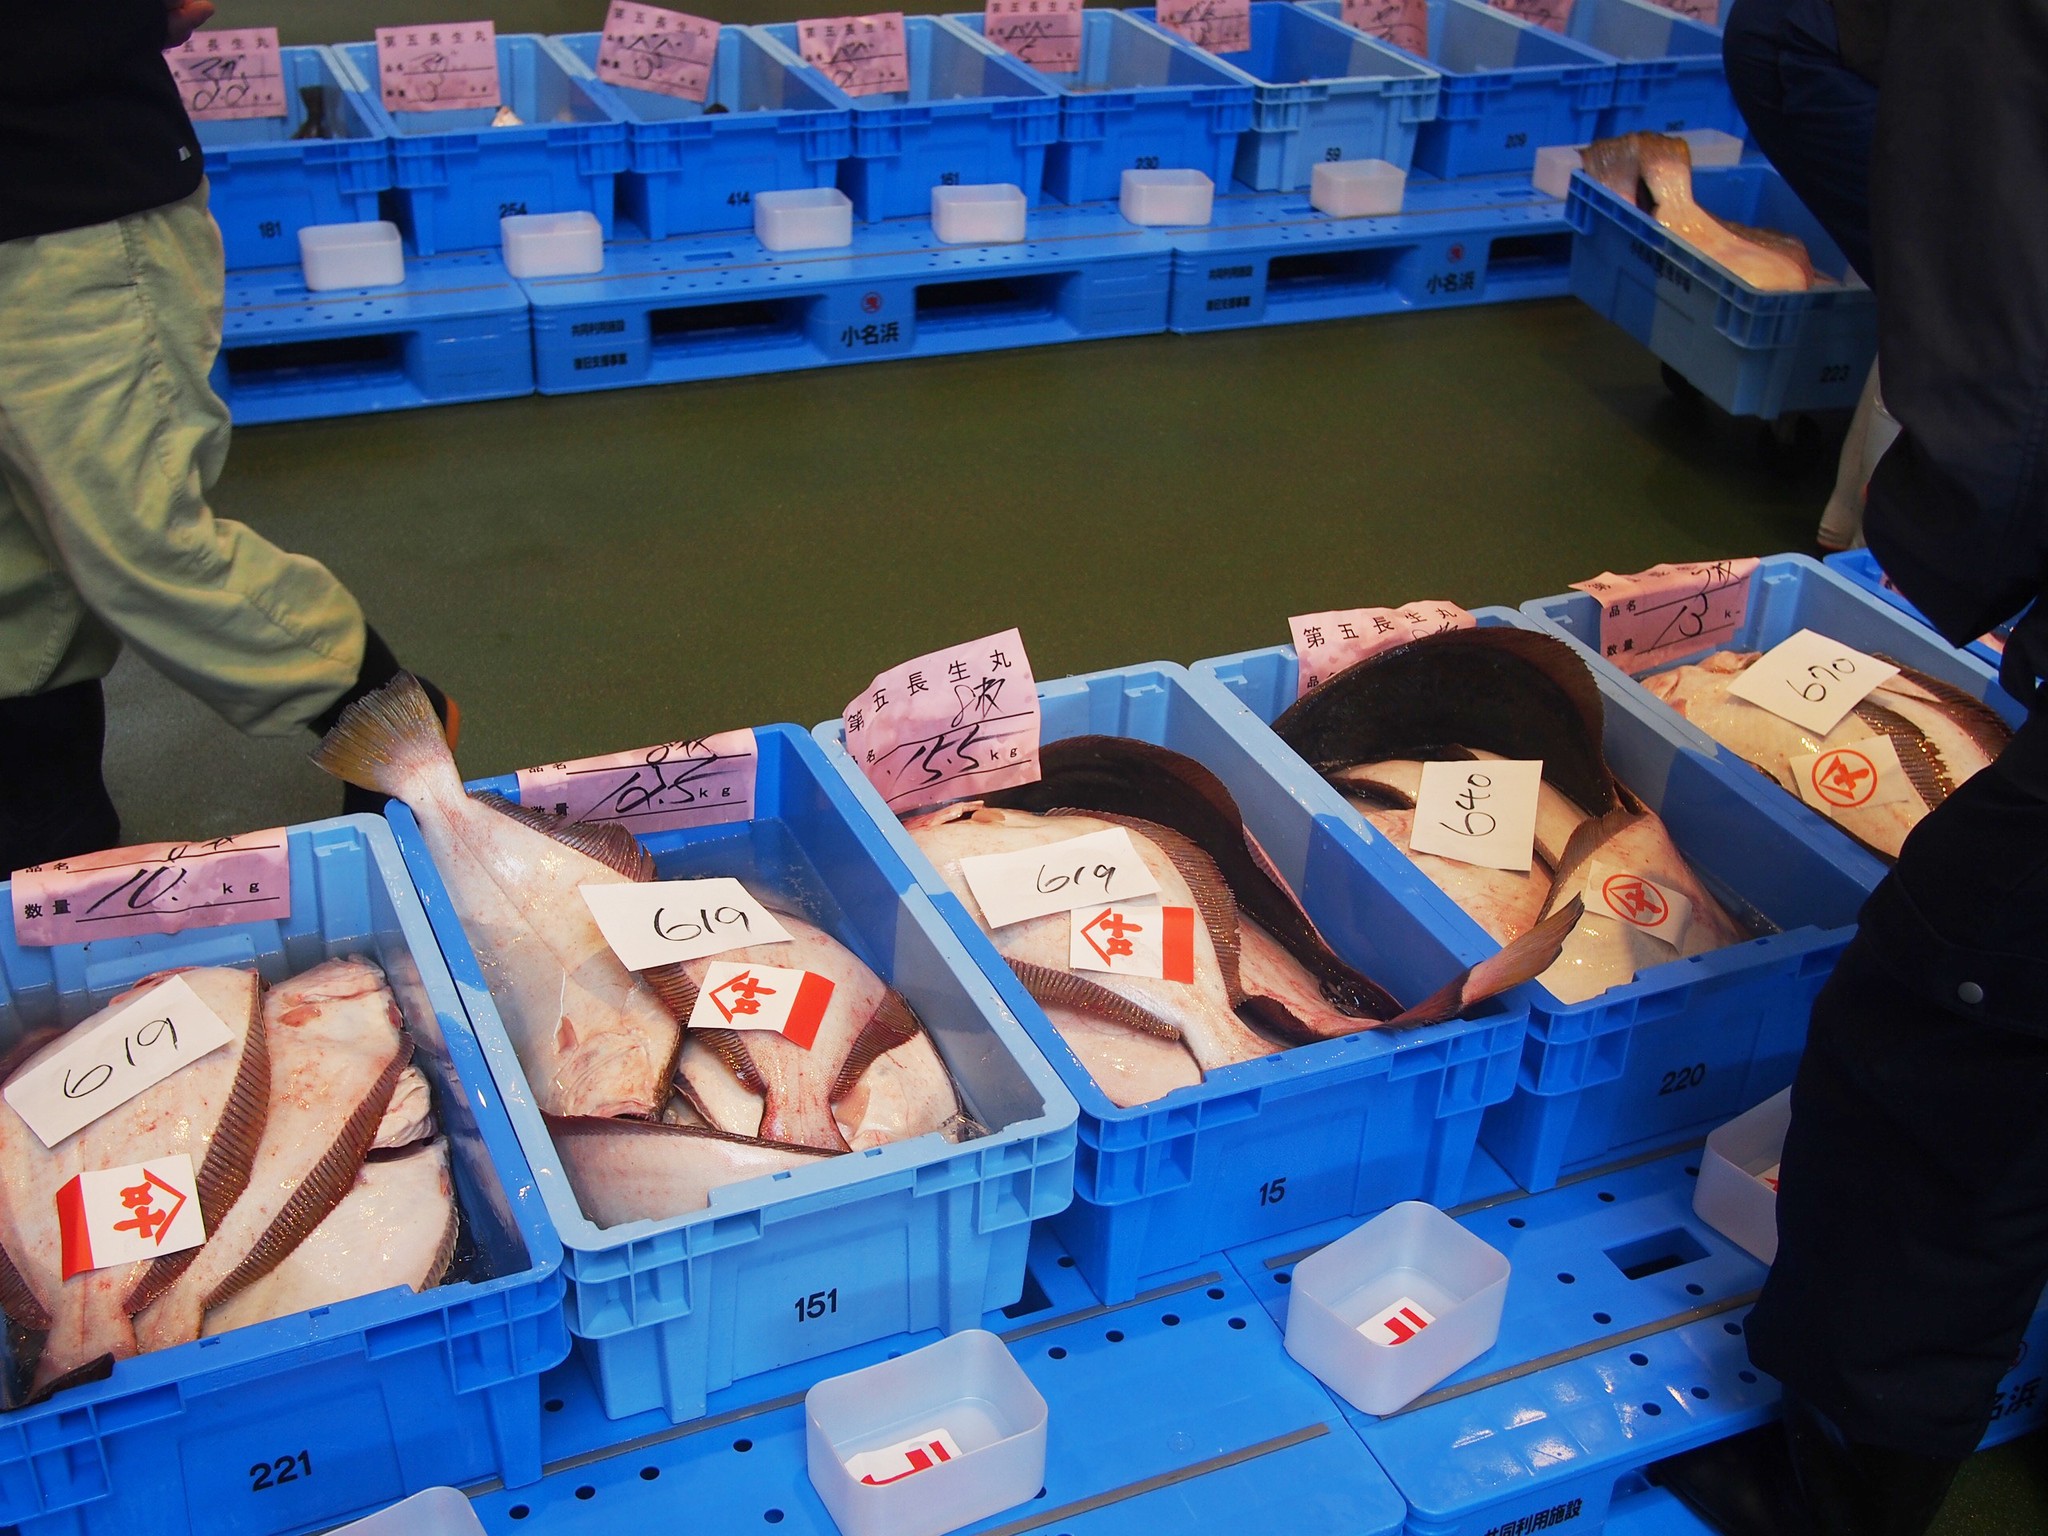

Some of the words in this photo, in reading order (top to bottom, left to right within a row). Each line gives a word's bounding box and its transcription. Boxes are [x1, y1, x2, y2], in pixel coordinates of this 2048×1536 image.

[1426, 270, 1476, 295] 小名浜
[840, 321, 899, 348] 小名浜
[1608, 600, 1637, 618] 品名
[1303, 607, 1458, 649] 第五長生丸
[847, 649, 1012, 734] 第五長生丸
[1438, 773, 1497, 837] 640
[1036, 864, 1117, 895] 619
[24, 899, 71, 919] 数量
[222, 882, 260, 895] kg
[653, 906, 752, 942] 619
[63, 1017, 179, 1100] 619
[1658, 1062, 1706, 1096] 220
[1259, 1176, 1287, 1207] 15
[794, 1288, 838, 1323] 151
[250, 1449, 312, 1492] 221
